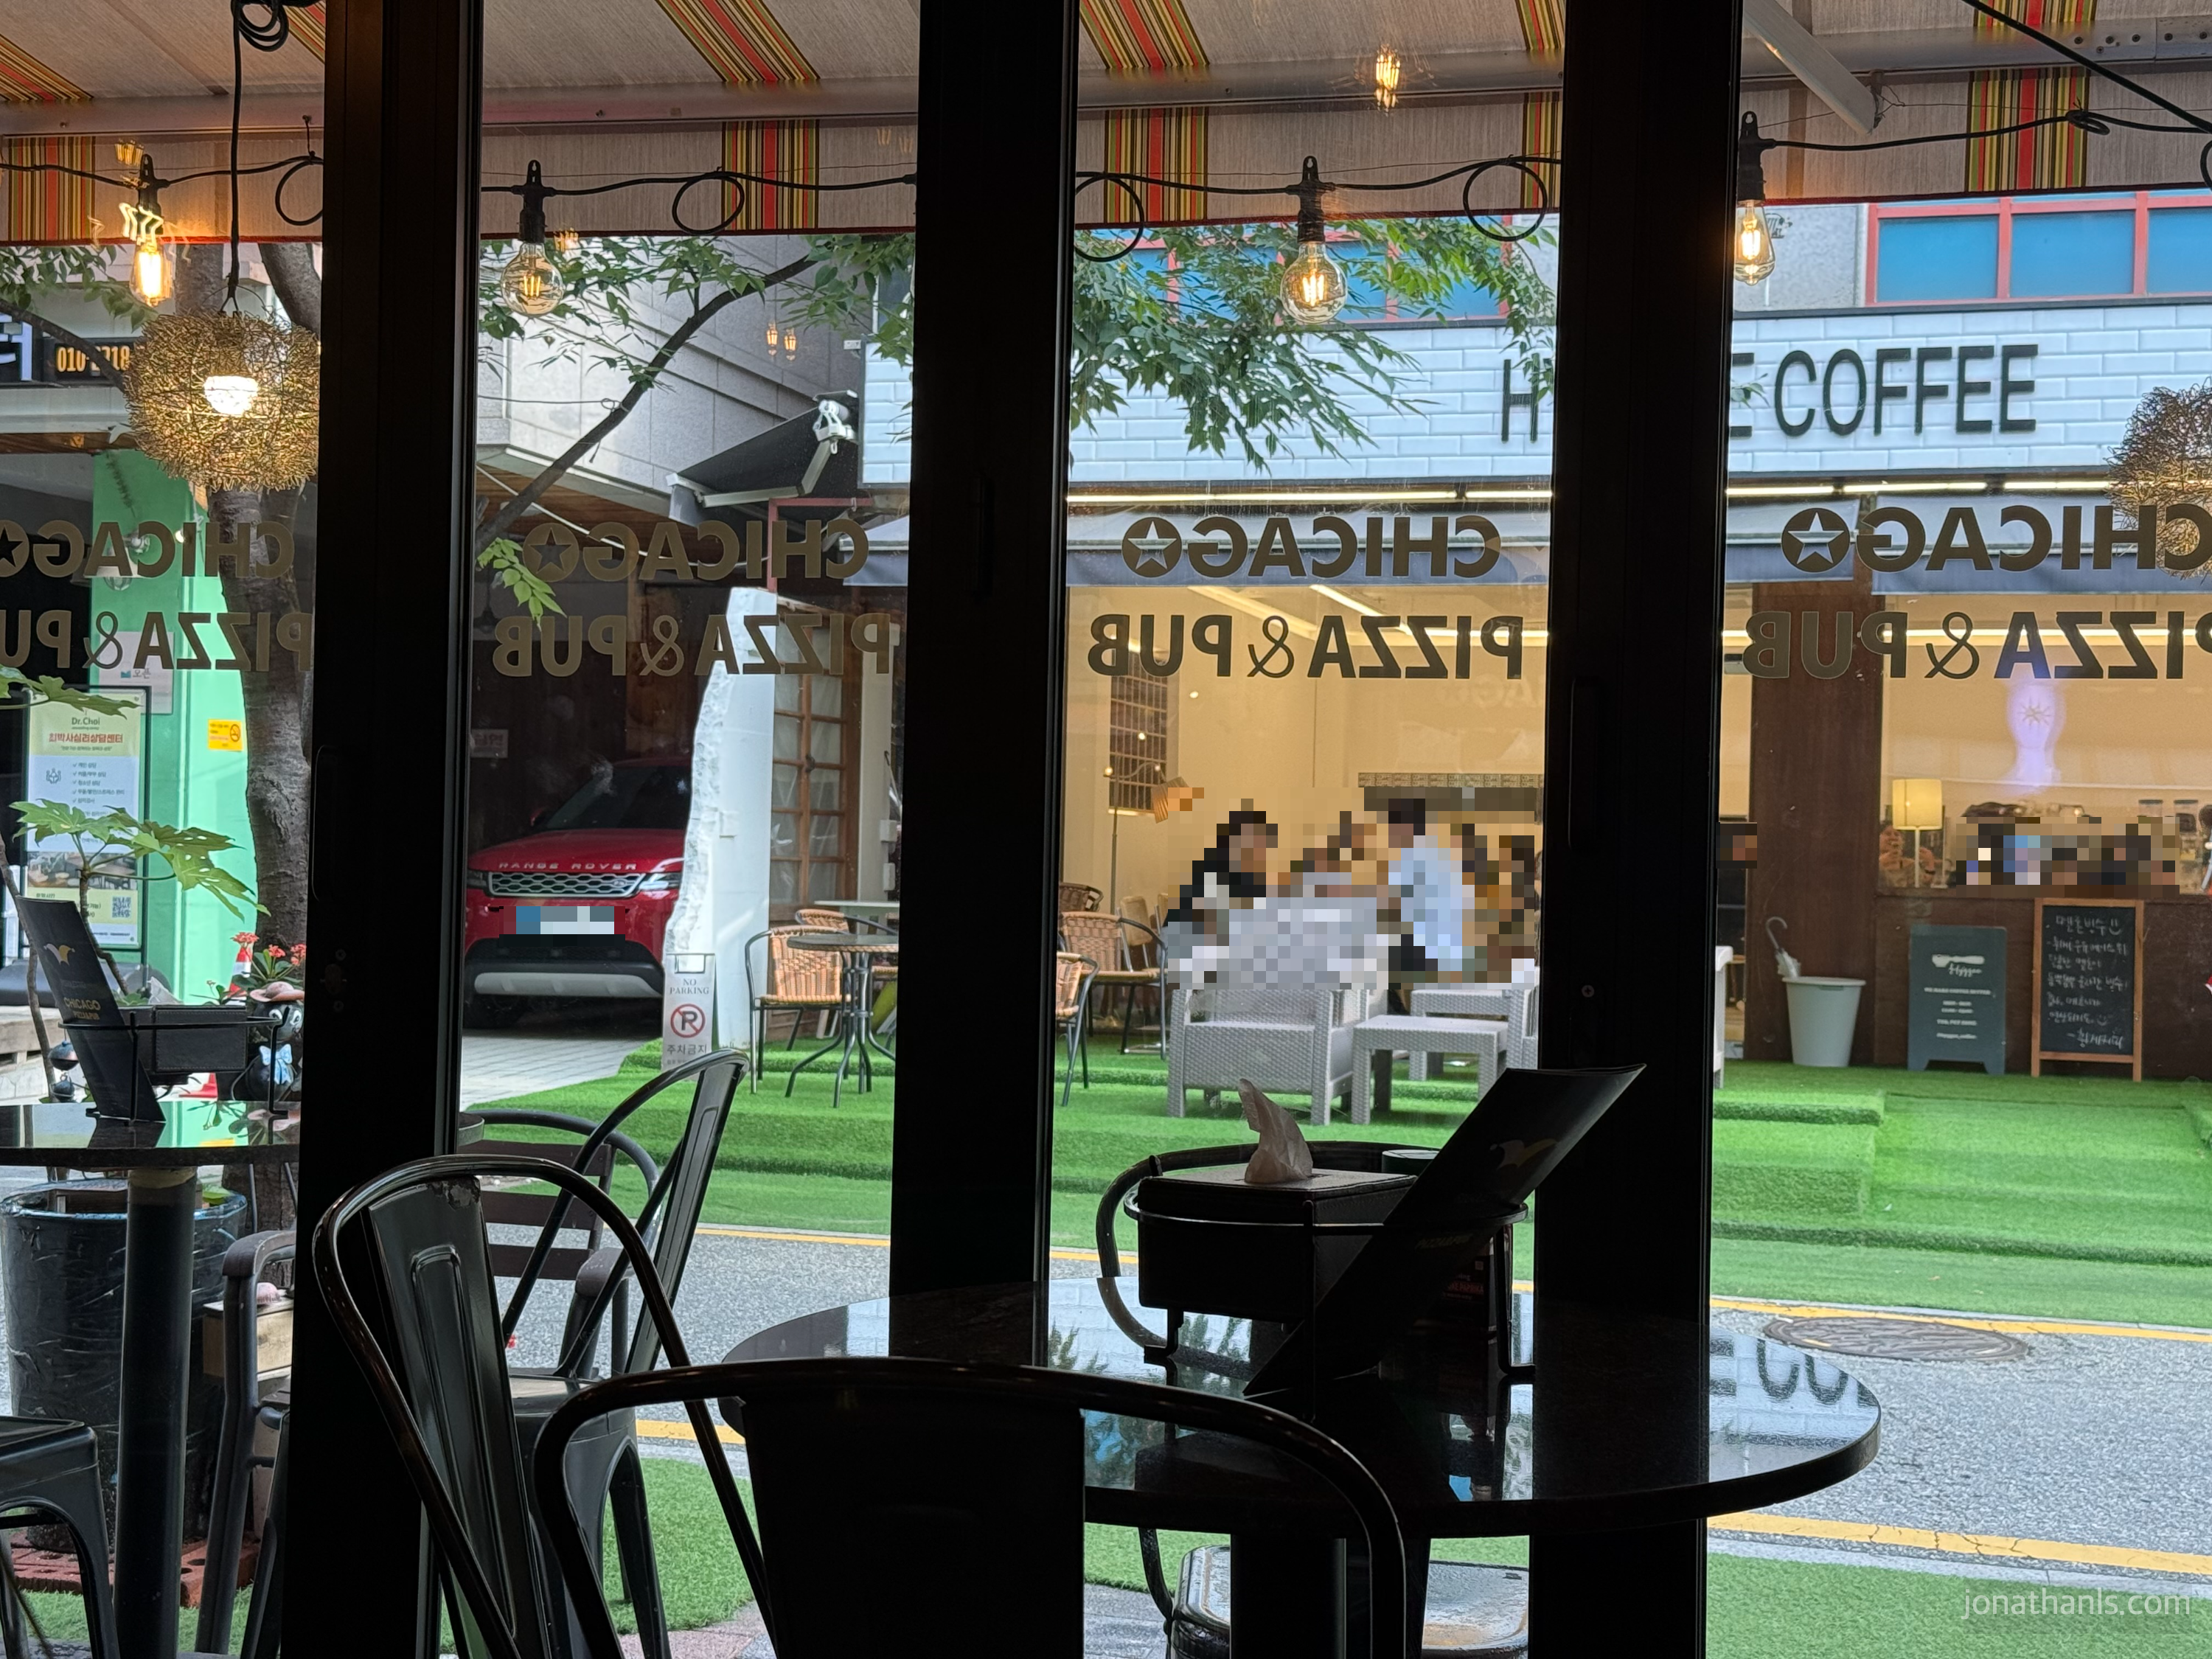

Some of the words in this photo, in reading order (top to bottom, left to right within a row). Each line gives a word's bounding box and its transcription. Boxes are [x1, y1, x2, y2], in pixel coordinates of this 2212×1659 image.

[1774, 344, 2039, 438] COFFEE
[669, 987, 709, 995] PARKING
[667, 1044, 707, 1055] 주차금지
